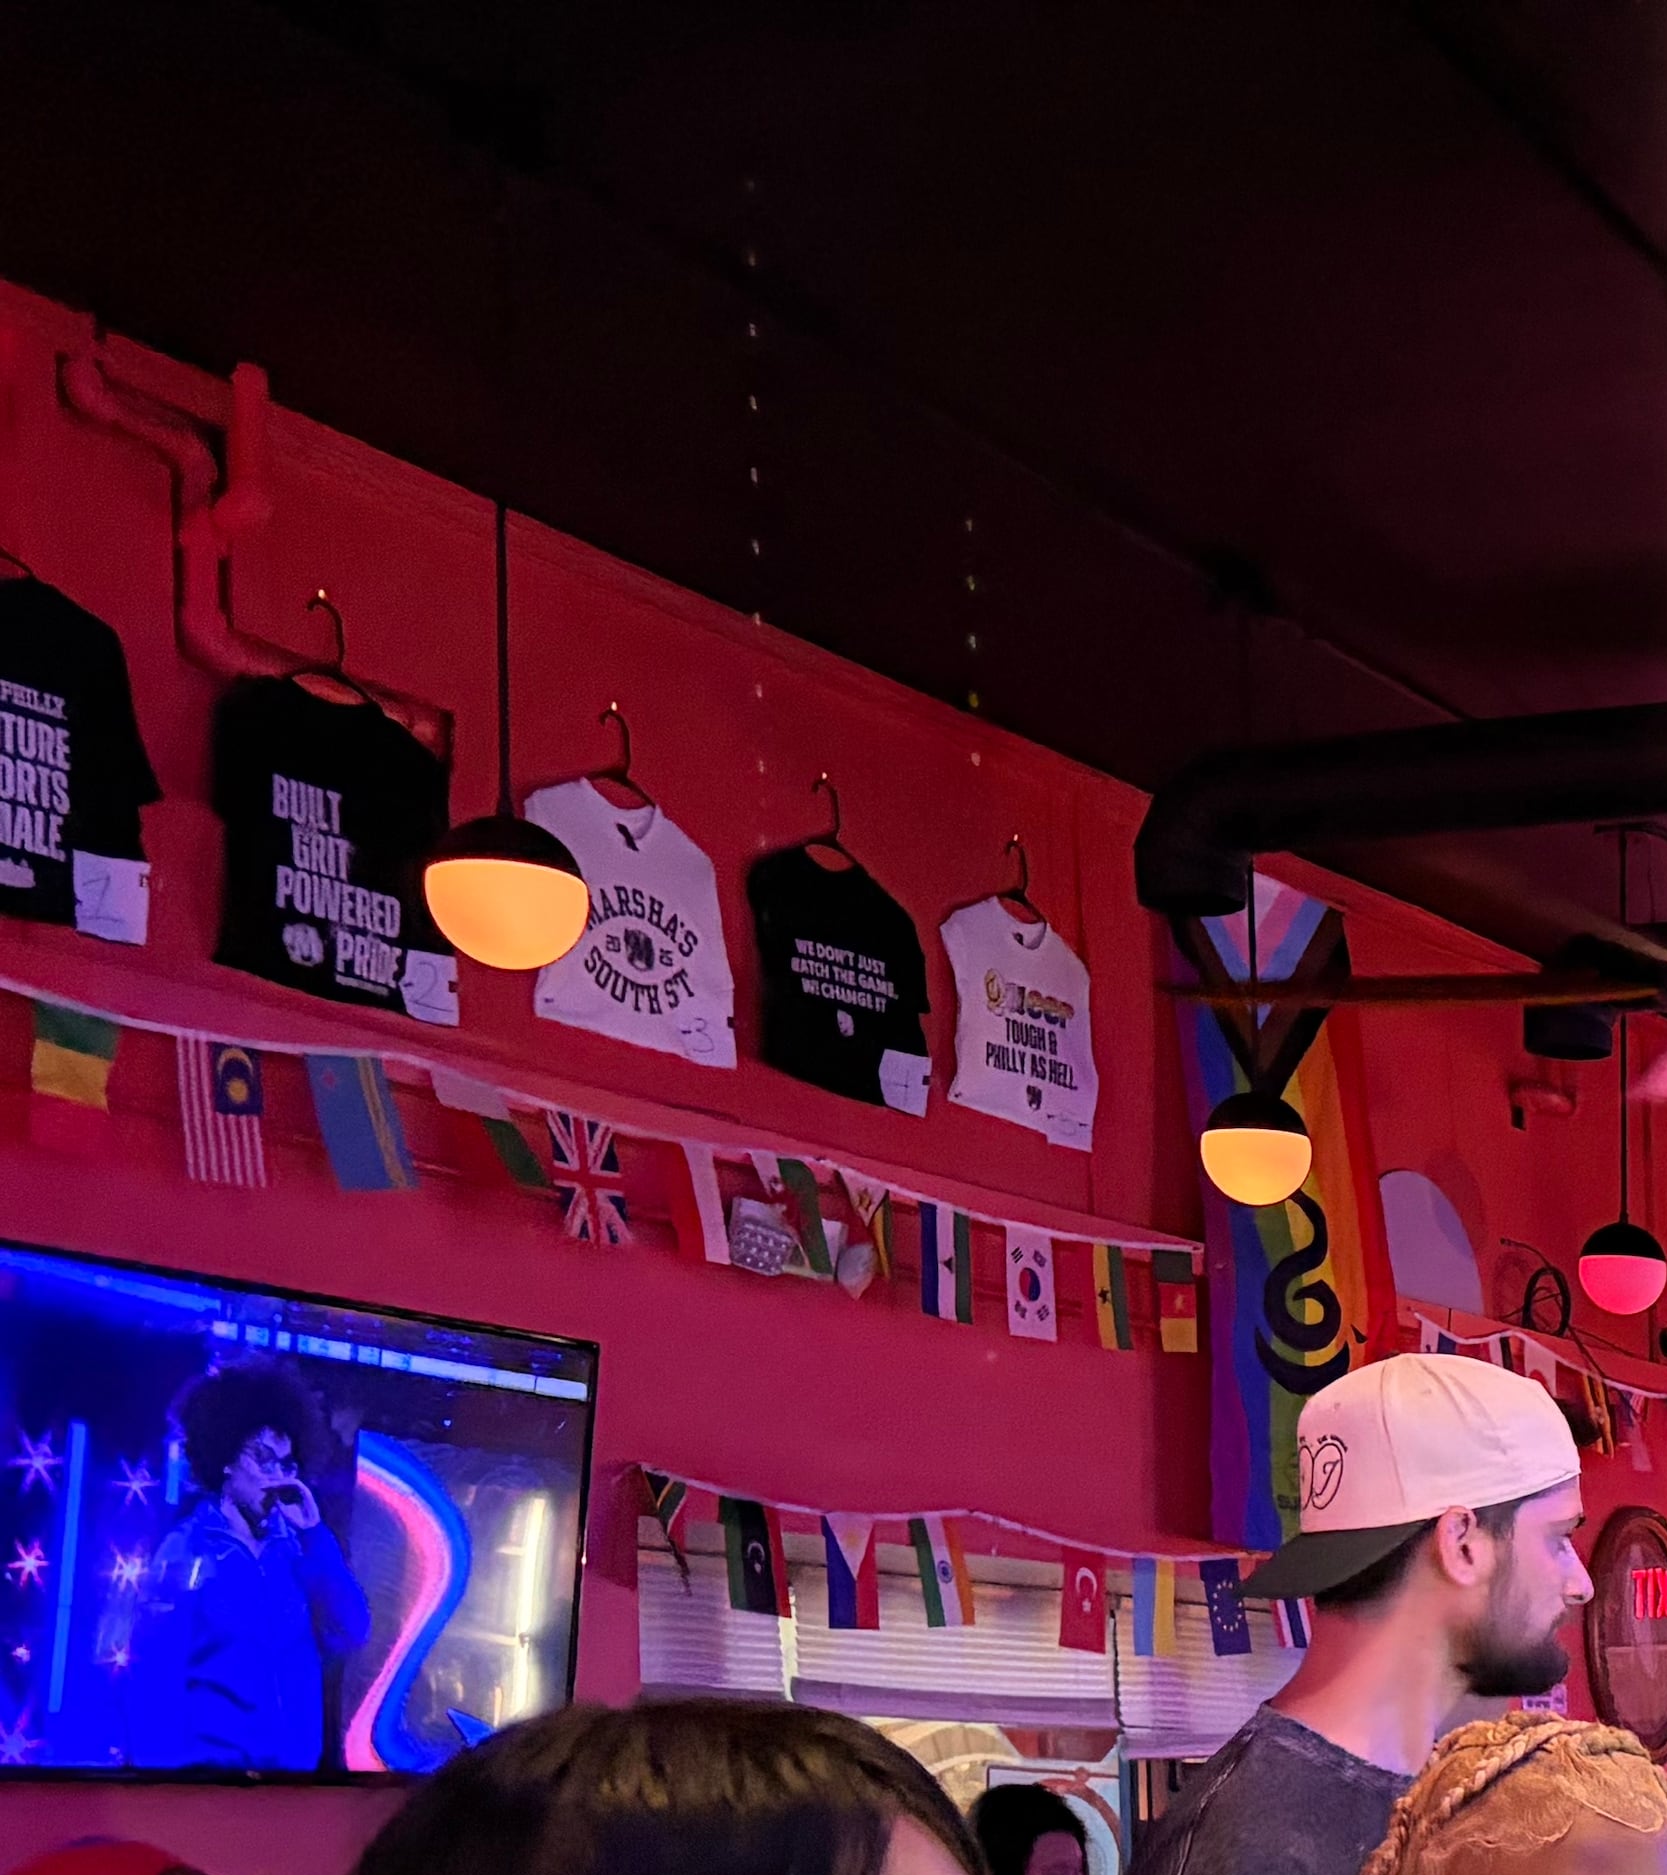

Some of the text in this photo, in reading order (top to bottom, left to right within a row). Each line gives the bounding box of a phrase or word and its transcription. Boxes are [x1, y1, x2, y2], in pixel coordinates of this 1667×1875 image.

[272, 773, 343, 833] BUILT
[276, 865, 401, 938] POWERED
[335, 930, 402, 989] PRIDE
[584, 946, 694, 1015] SOUTH ST
[833, 967, 857, 986] THE
[858, 954, 885, 976] JUST
[1005, 1018, 1046, 1051] TOUGH
[985, 1041, 1026, 1074] PHILLY
[1030, 1054, 1047, 1081] AS
